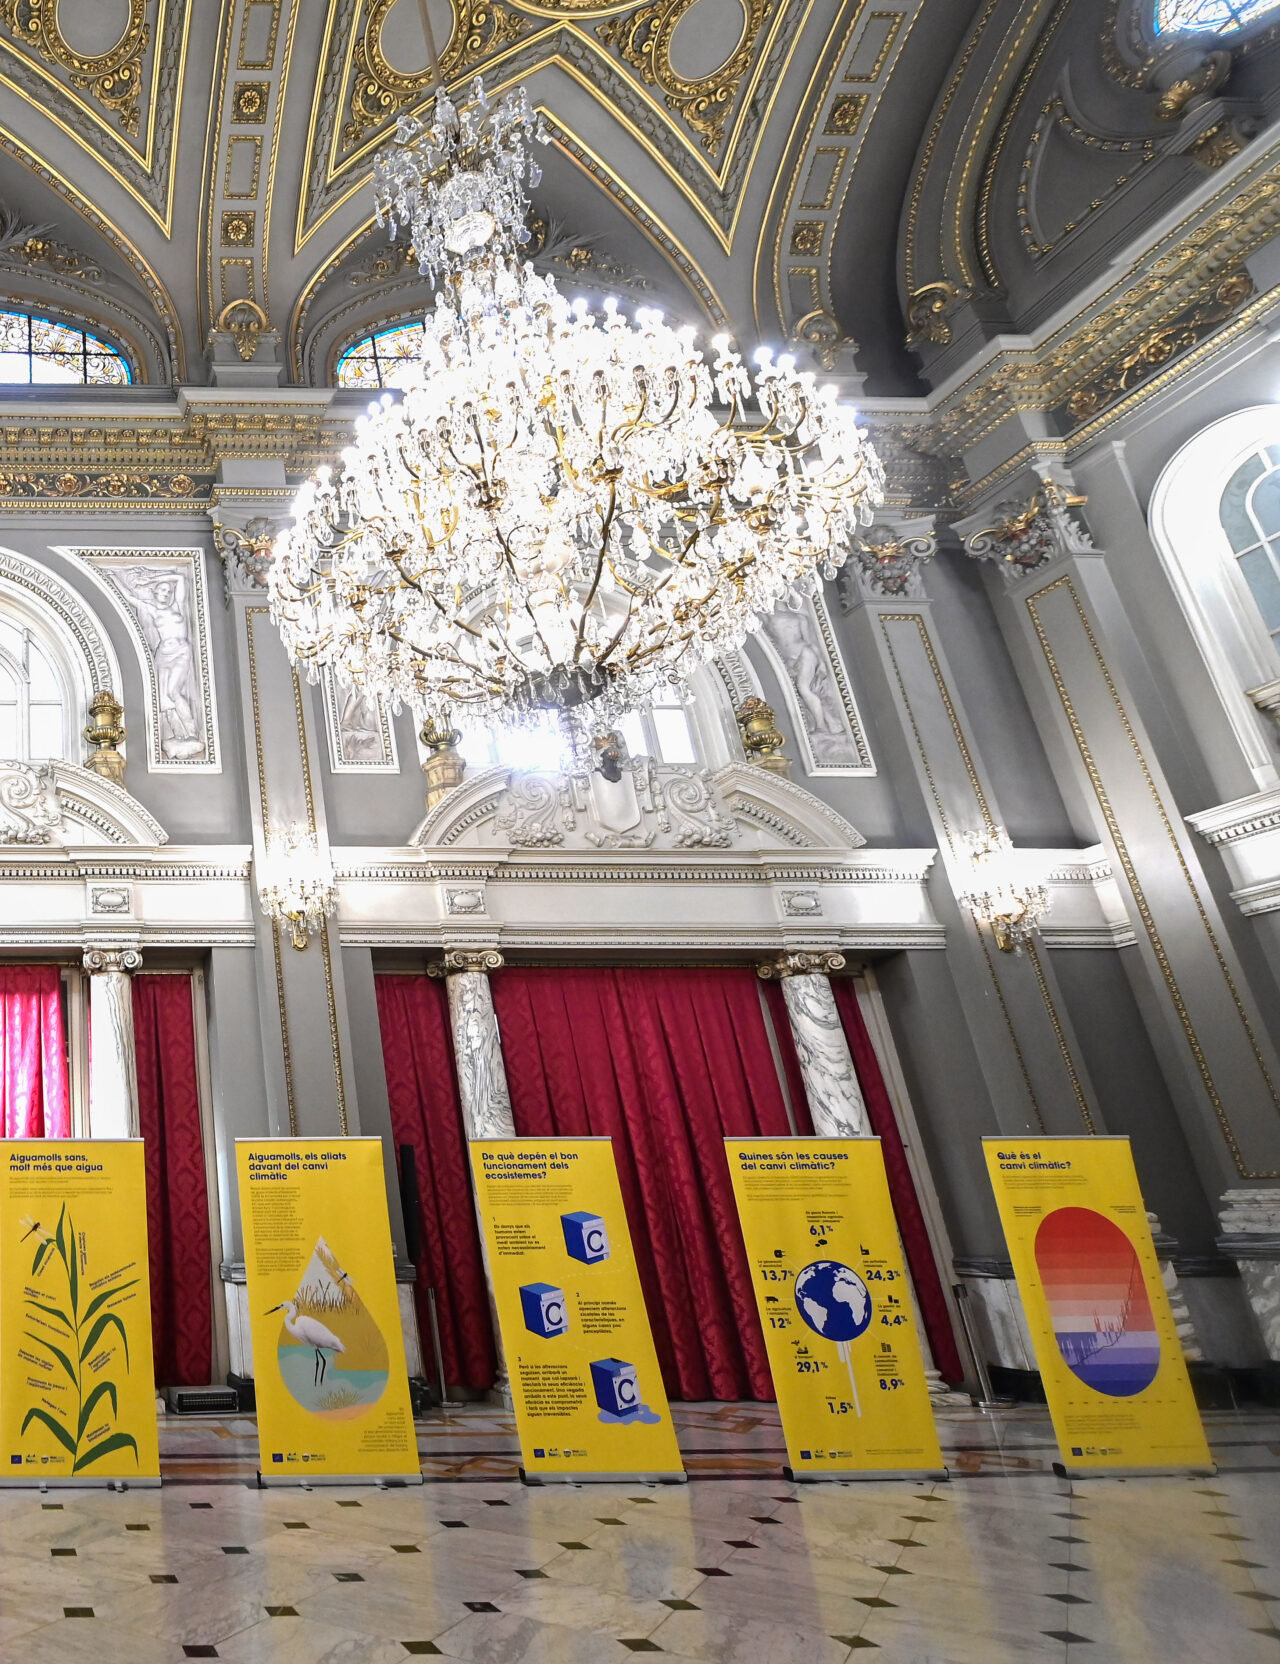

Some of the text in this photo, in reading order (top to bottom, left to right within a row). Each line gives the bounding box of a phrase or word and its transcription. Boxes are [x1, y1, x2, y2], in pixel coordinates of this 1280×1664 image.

[9, 1153, 88, 1163] Aiguamolls sans,
[248, 1152, 347, 1162] Aiguamolls, els aliats
[482, 1152, 494, 1160] De
[497, 1152, 515, 1161] què
[549, 1152, 558, 1160] el
[560, 1152, 578, 1160] bon
[738, 1152, 849, 1160] Quines són les causes
[997, 1151, 1041, 1160] Què és el
[9, 1162, 103, 1173] molt més que aigua
[249, 1161, 328, 1171] davant del canvi
[483, 1161, 569, 1170] funcionament dels
[741, 1161, 835, 1170] del canvi climàtic?
[1000, 1161, 1071, 1169] canvi climàtic?
[249, 1171, 288, 1181] climàtic
[485, 1171, 547, 1180] ecosistemes?
